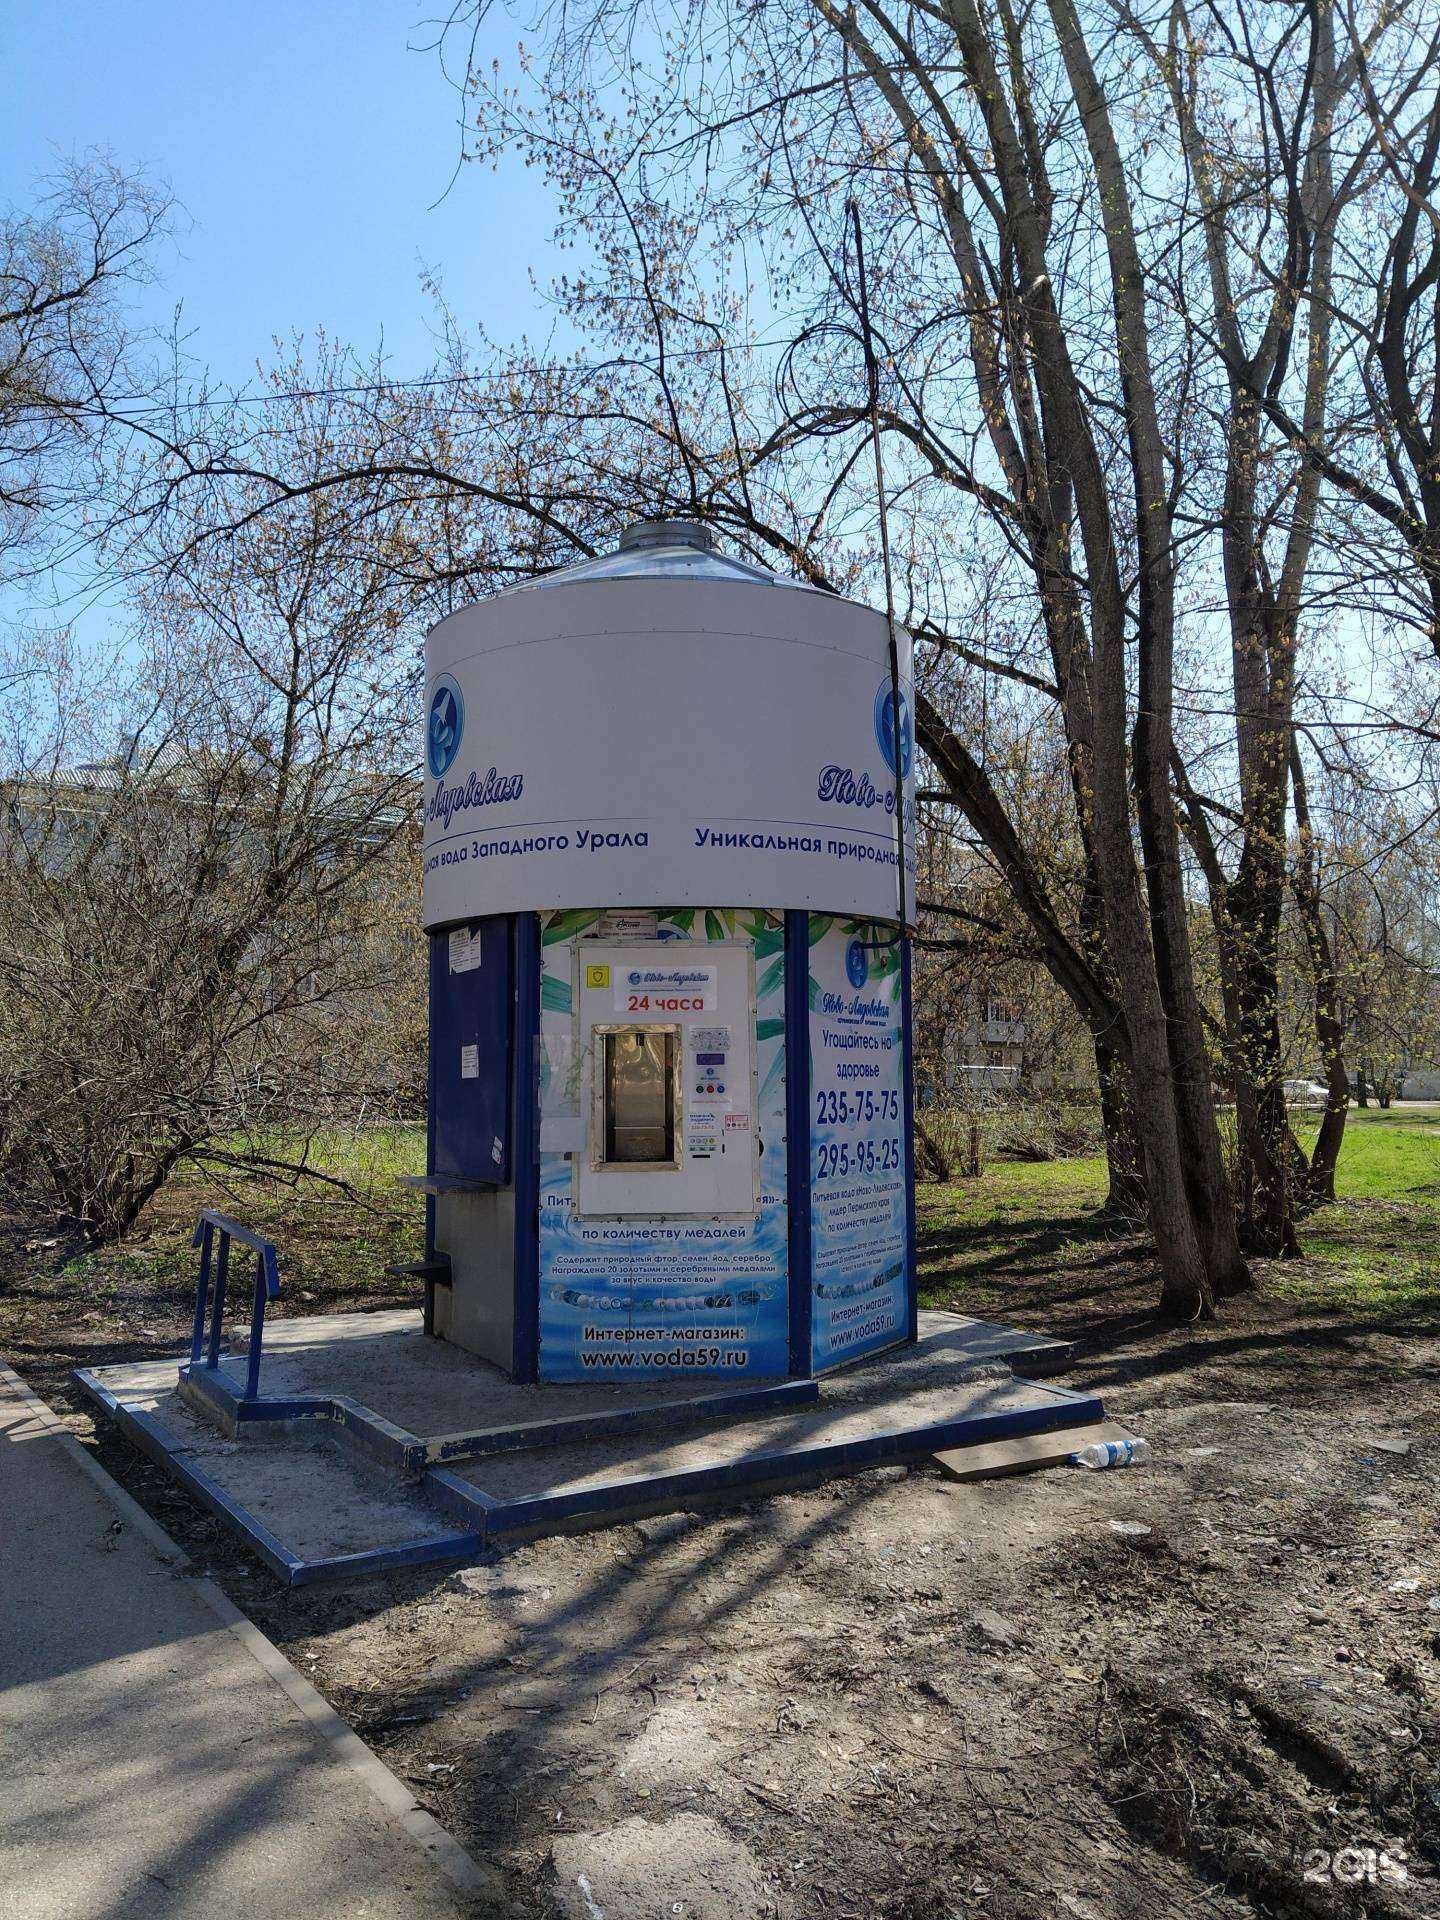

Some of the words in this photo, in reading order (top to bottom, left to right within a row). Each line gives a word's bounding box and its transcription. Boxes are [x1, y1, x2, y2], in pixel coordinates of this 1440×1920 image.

[441, 847, 468, 866] вода
[472, 836, 569, 859] Западного
[576, 830, 649, 852] Урала
[694, 828, 822, 853] Уникальная
[827, 839, 900, 867] природная
[628, 995, 650, 1011] 24
[655, 998, 704, 1011] часа
[822, 1029, 879, 1051] Угощайтесь
[881, 1037, 892, 1050] на
[836, 1063, 880, 1080] здоровье
[816, 1090, 899, 1125] 235-75-75
[816, 1138, 900, 1179] 295-95-25
[547, 1194, 572, 1206] Пит
[761, 1195, 779, 1204] я»-
[582, 1230, 599, 1240] по
[603, 1229, 681, 1241] количеству
[684, 1226, 746, 1239] медалей
[556, 1256, 601, 1265] Содержит
[603, 1254, 652, 1264] природный
[732, 1254, 771, 1264] серебро
[551, 1266, 606, 1275] Награждено
[607, 1265, 618, 1273] 20
[670, 1263, 731, 1273] серебряными
[732, 1265, 776, 1273] медалями
[694, 1276, 716, 1284] воды
[584, 1327, 745, 1343] Интернет-магазин:
[830, 1314, 895, 1347] www.voda59.ru
[582, 1348, 746, 1366] www.voda59.ru
